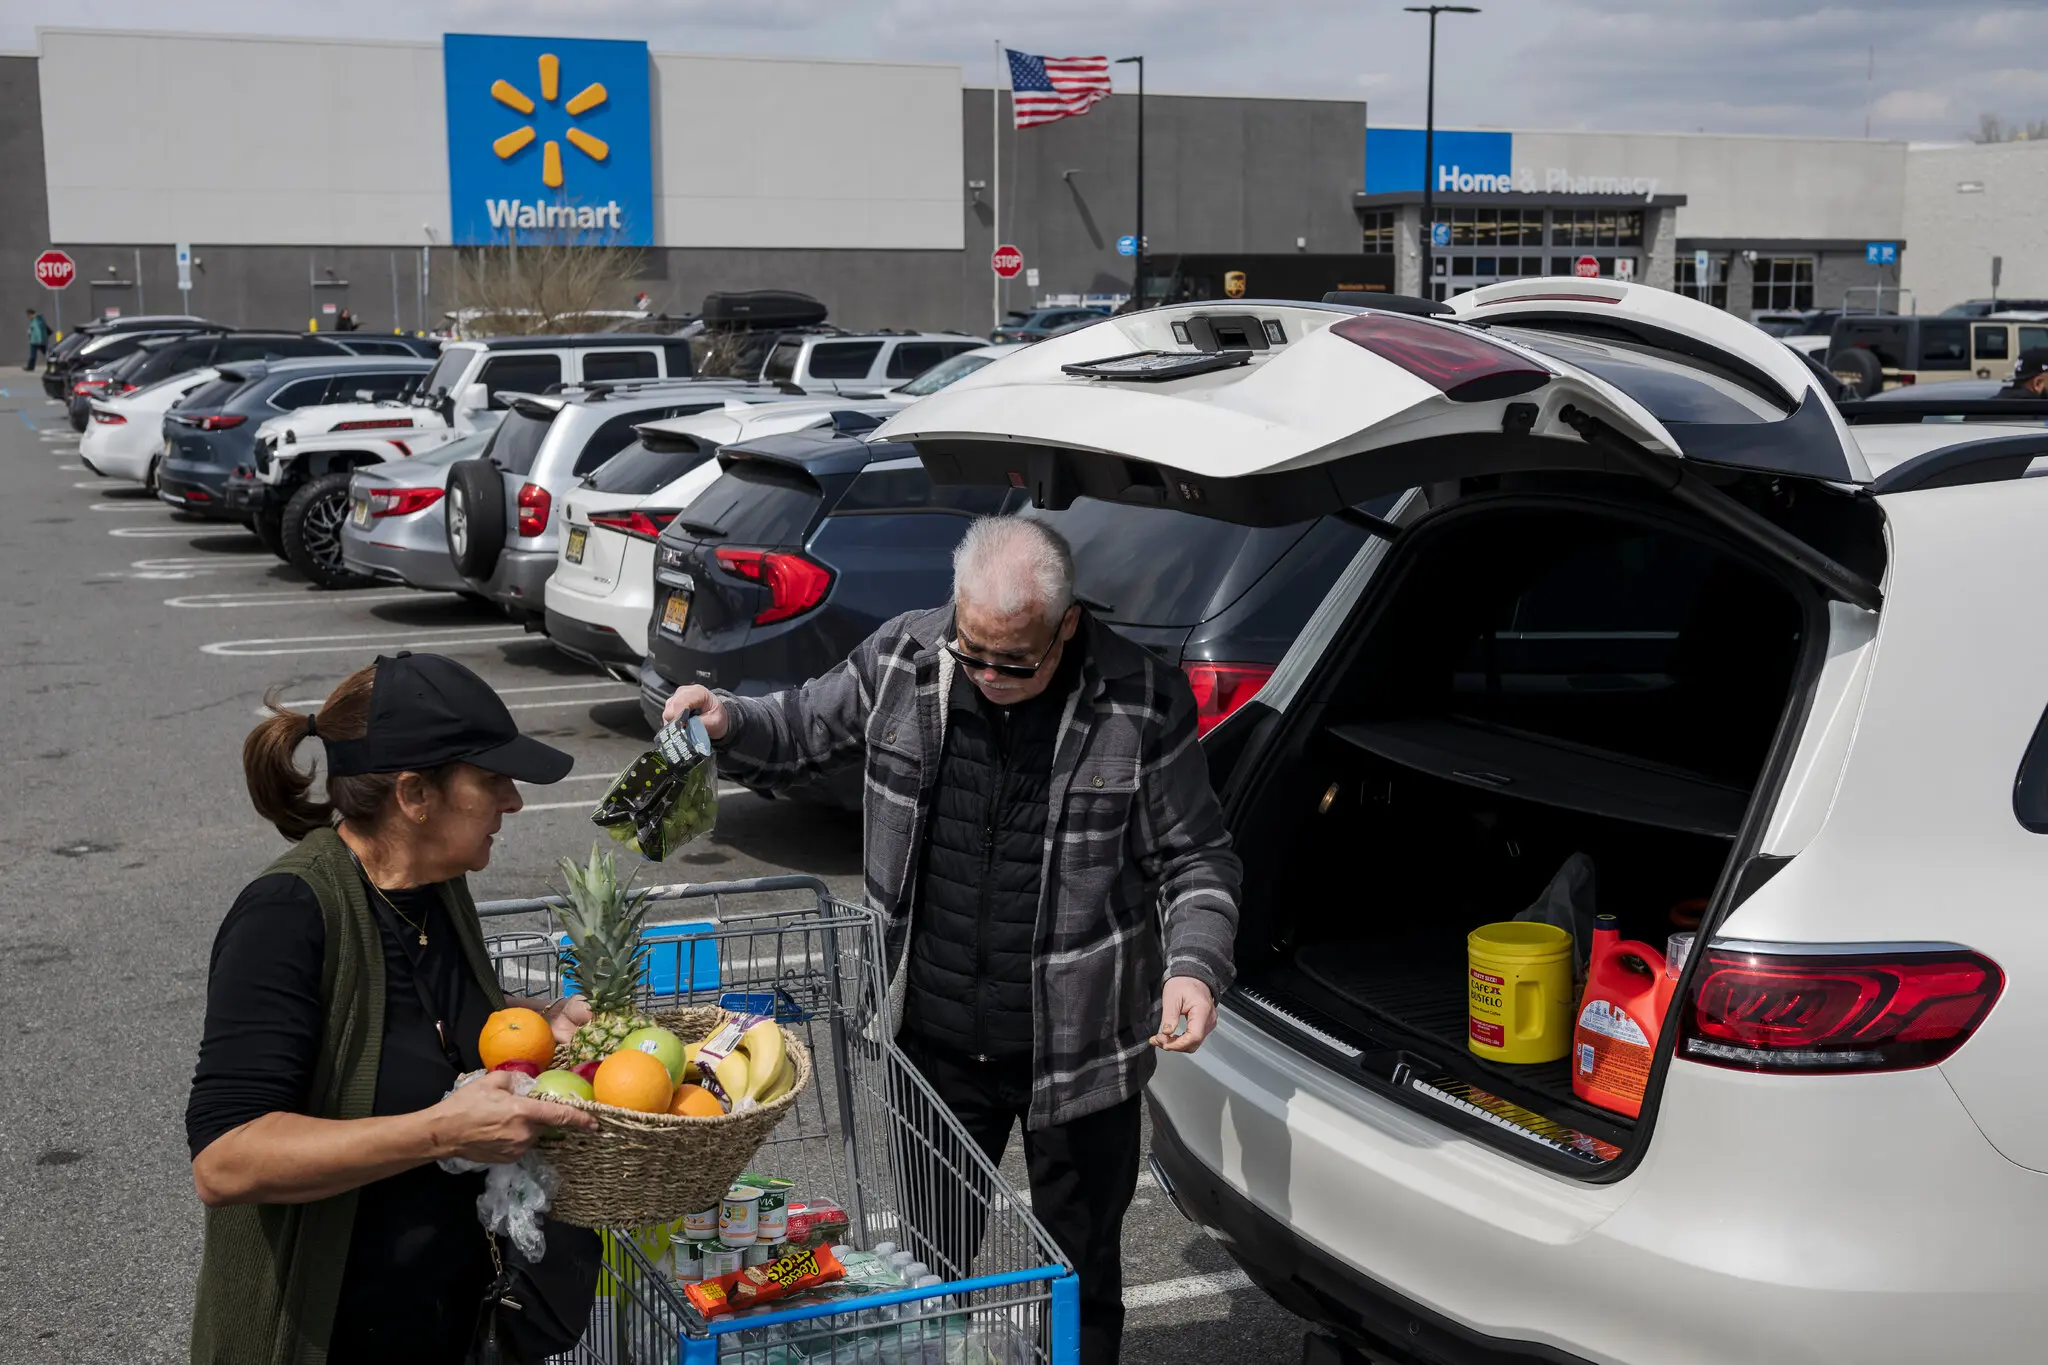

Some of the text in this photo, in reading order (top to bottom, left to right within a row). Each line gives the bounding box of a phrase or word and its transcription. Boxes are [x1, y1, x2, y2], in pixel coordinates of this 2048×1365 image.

[1438, 165, 1659, 203] Home & Pharmacy
[486, 199, 621, 229] Walmart
[38, 261, 72, 278] STOP
[994, 254, 1021, 268] STOP
[1576, 264, 1598, 277] STOP
[1470, 989, 1503, 1008] BUSTELO
